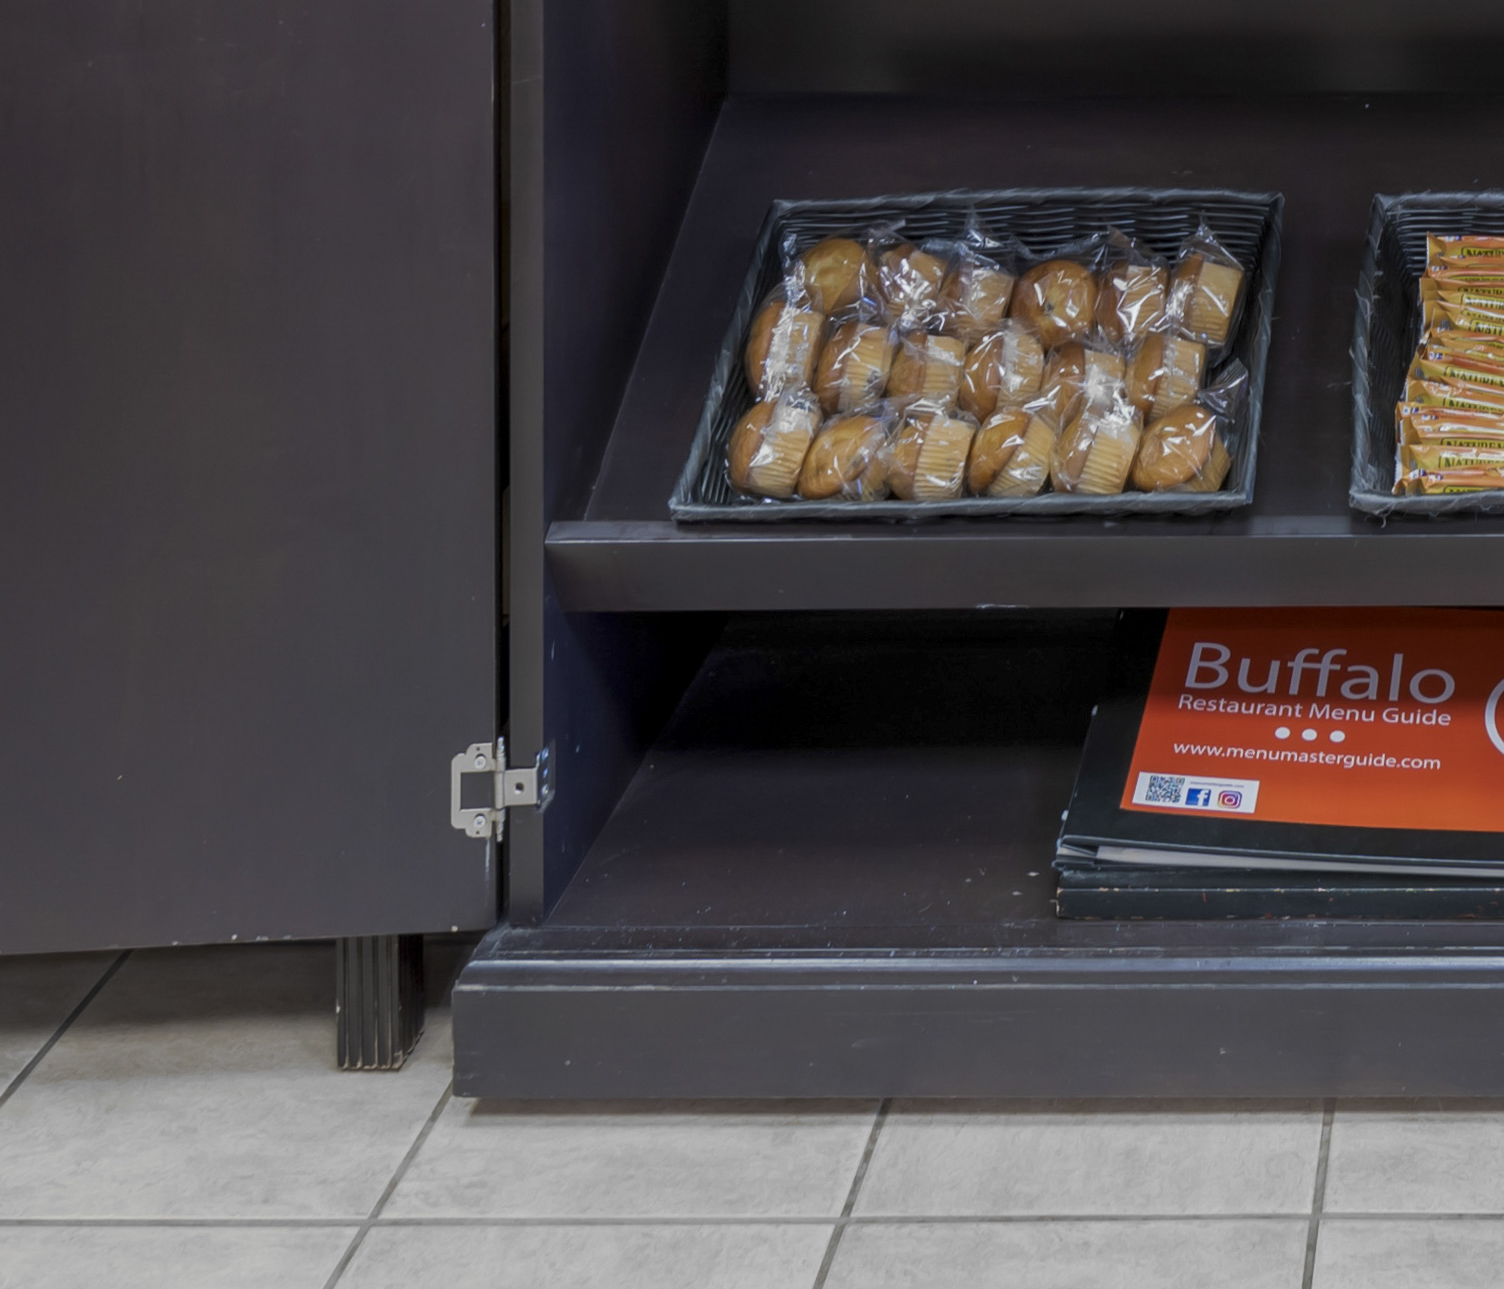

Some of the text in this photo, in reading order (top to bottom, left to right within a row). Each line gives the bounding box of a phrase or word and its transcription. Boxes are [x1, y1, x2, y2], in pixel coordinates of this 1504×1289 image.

[1184, 641, 1456, 704] Buffalo
[1178, 693, 1452, 727] Restaurant Menu Guide
[1172, 742, 1442, 772] www.menumasterguide.com
